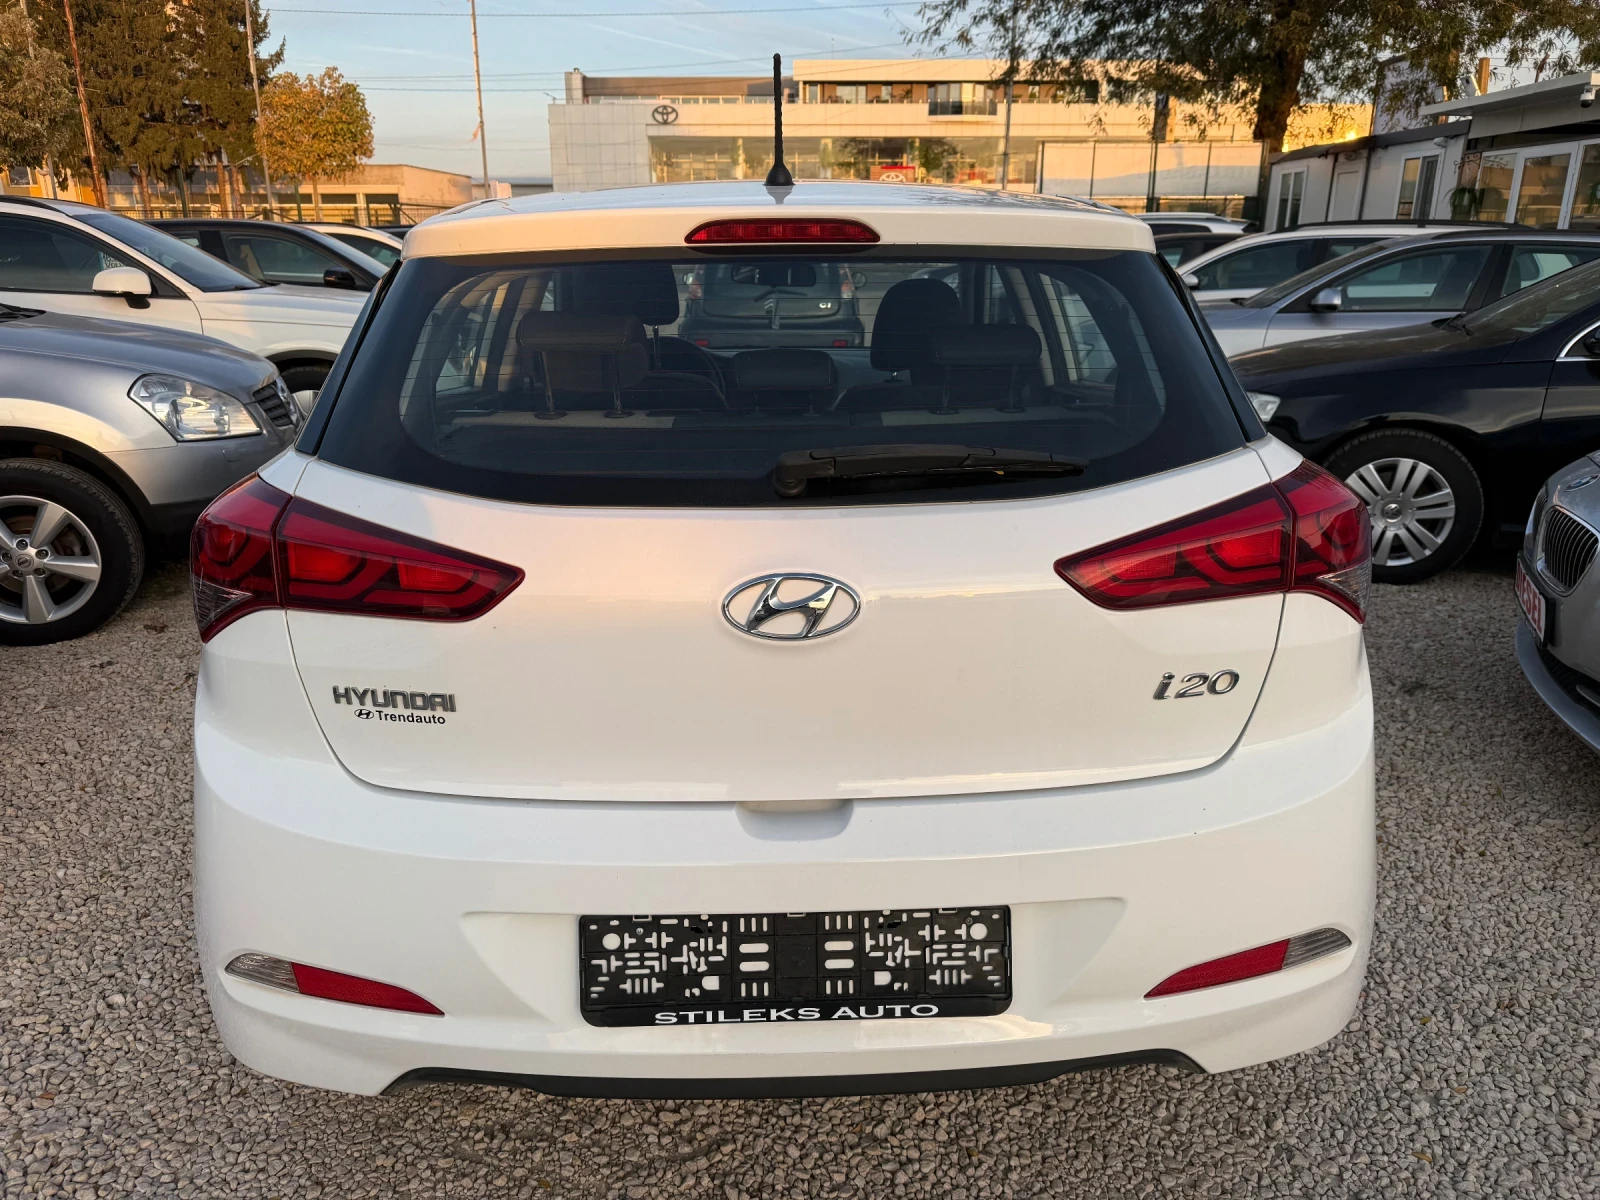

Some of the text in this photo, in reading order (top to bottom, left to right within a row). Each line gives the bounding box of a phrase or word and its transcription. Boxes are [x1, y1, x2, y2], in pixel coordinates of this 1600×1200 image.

[1515, 560, 1543, 636] DIESEL
[1152, 668, 1240, 700] i20
[332, 685, 457, 712] HYUNDAI
[375, 709, 447, 725] Trendauto
[654, 1004, 939, 1024] STILEKS AUTO
